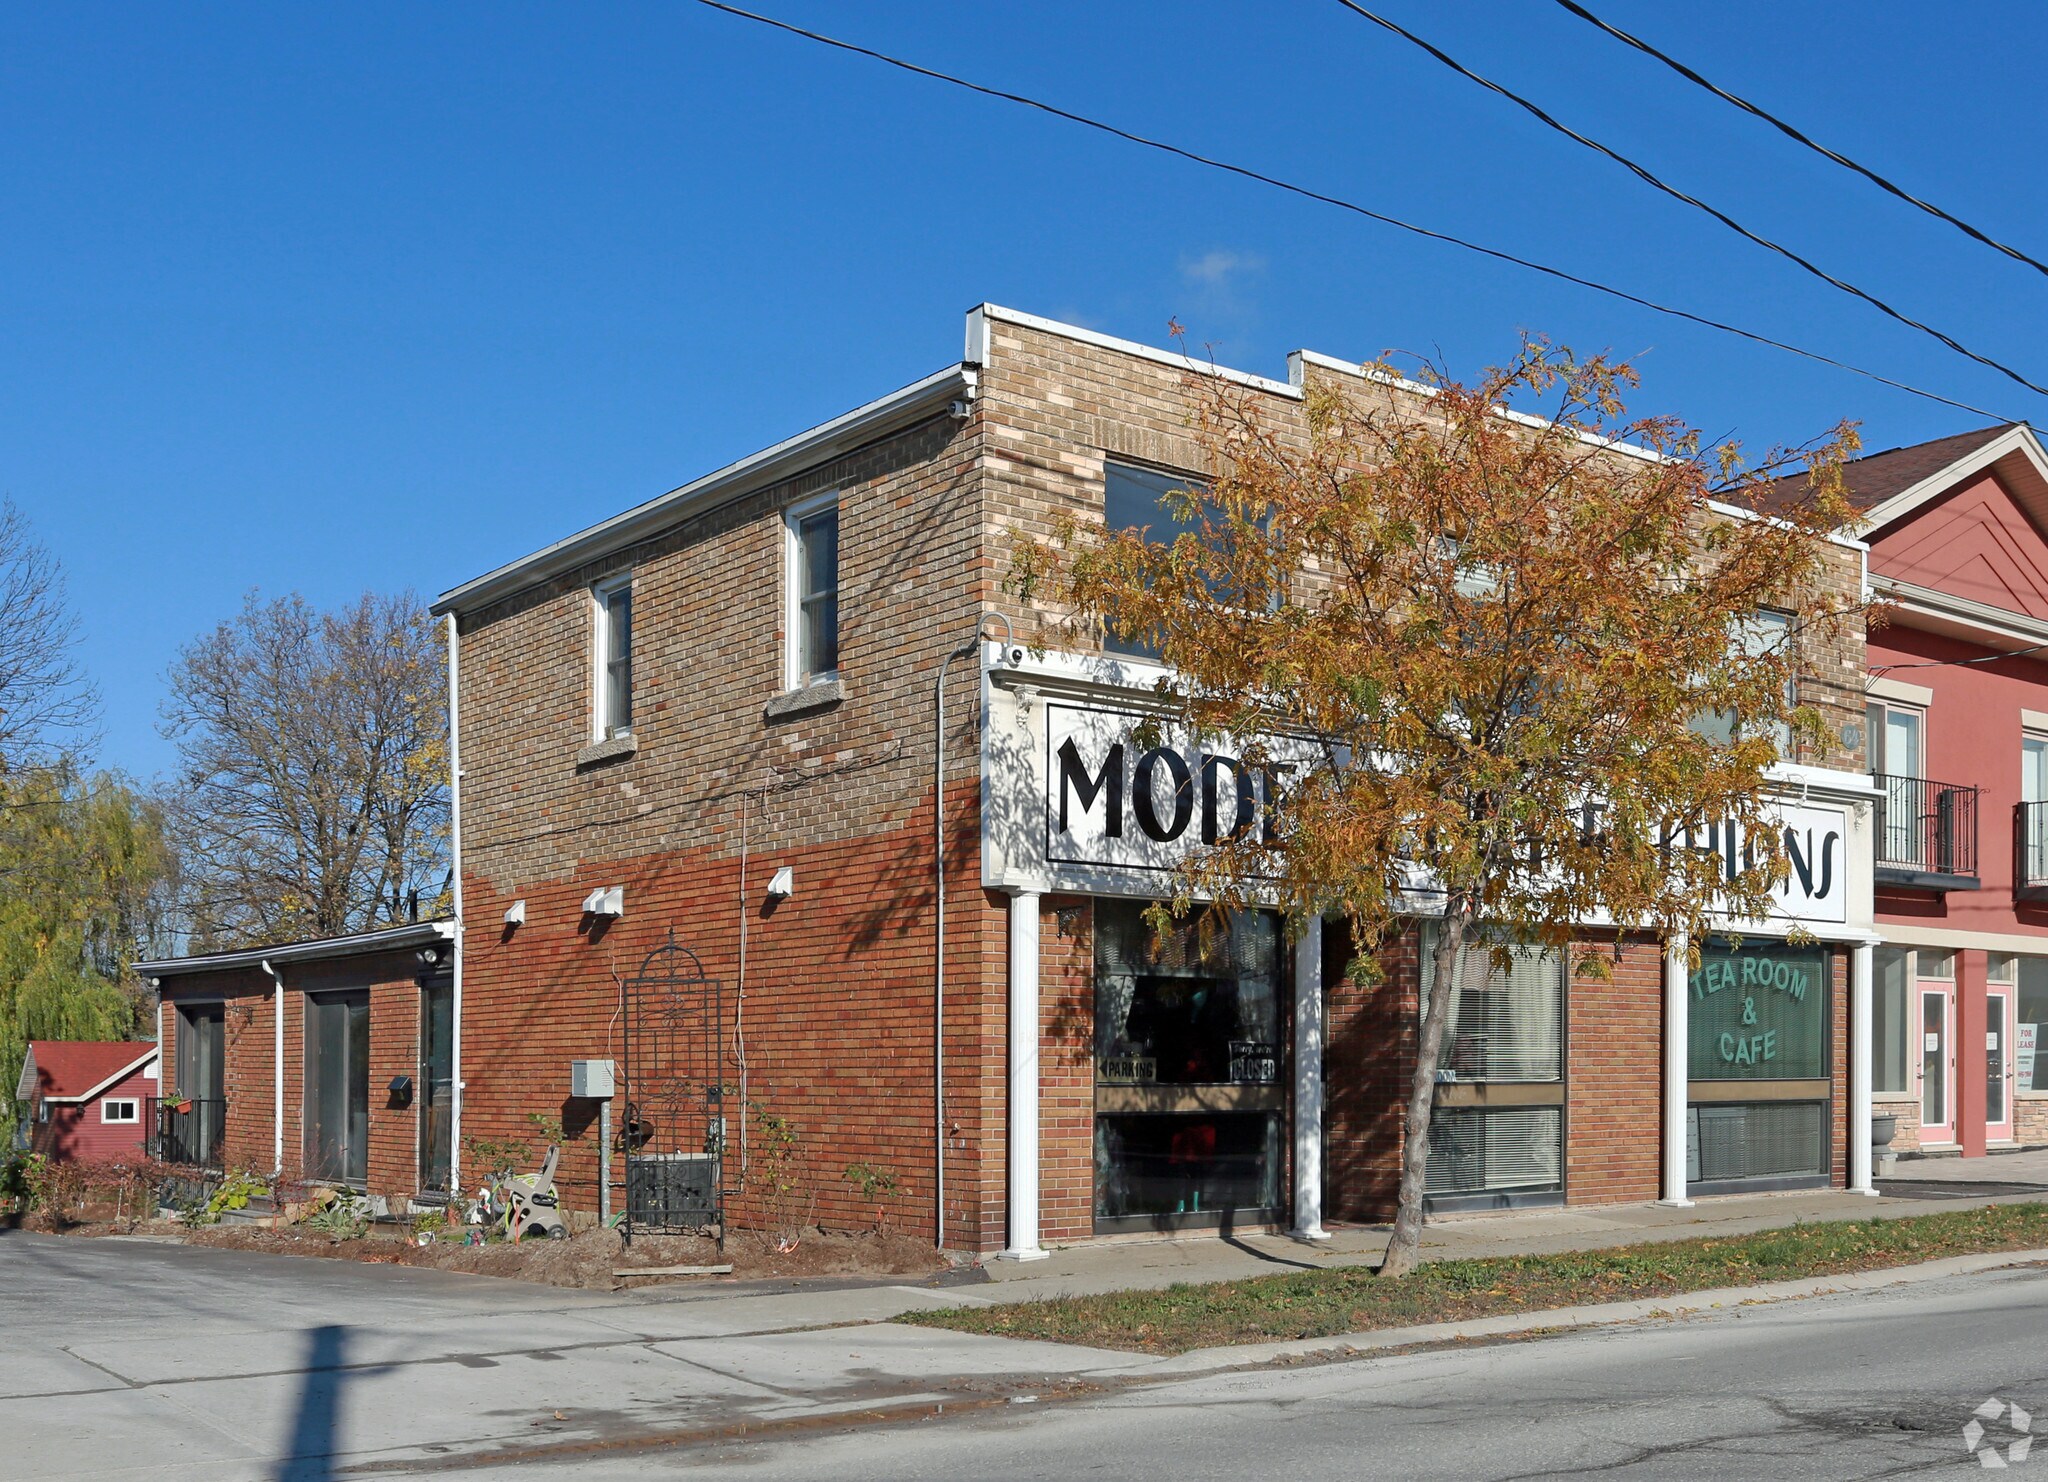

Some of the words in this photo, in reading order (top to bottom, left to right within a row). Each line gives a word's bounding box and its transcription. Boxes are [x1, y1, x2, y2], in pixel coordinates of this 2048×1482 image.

[1057, 735, 1375, 852] MODE
[1690, 960, 1736, 1000] TEA
[1743, 957, 1808, 1001] ROOM
[1743, 997, 1757, 1025] &
[2017, 1040, 2035, 1049] LEASE
[2020, 1029, 2033, 1038] FOR
[1721, 1029, 1776, 1065] CAFE
[1108, 1060, 1154, 1078] PARKING
[1233, 1058, 1275, 1080] CLOSED
